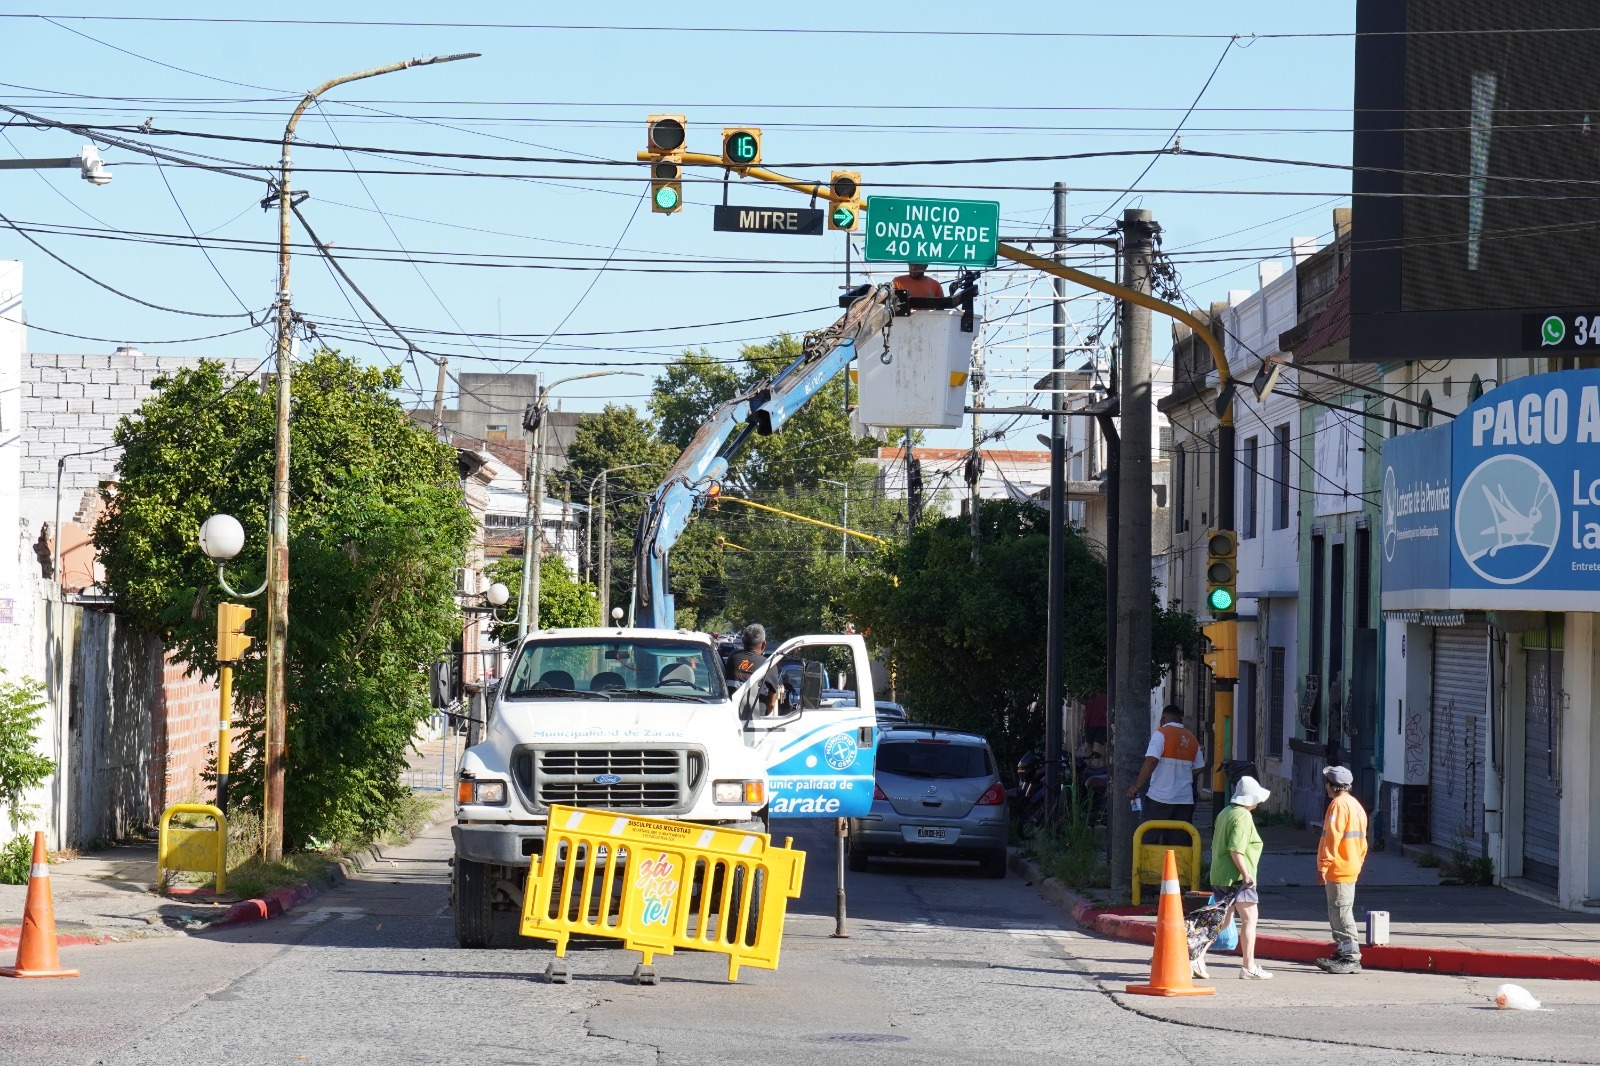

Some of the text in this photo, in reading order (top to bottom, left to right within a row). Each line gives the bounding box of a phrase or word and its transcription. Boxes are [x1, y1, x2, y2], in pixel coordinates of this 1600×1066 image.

[737, 136, 753, 158] 16
[739, 210, 798, 231] MITRE
[906, 205, 960, 222] INICIO
[875, 222, 990, 243] ONDA VERDE
[885, 240, 913, 255] 40
[917, 242, 944, 258] KM
[964, 244, 976, 260] H
[1472, 388, 1569, 446] PAGO
[625, 729, 640, 738] de
[839, 780, 853, 790] de
[628, 820, 652, 829] DISCULPE
[663, 825, 692, 834] MOLESTIAS
